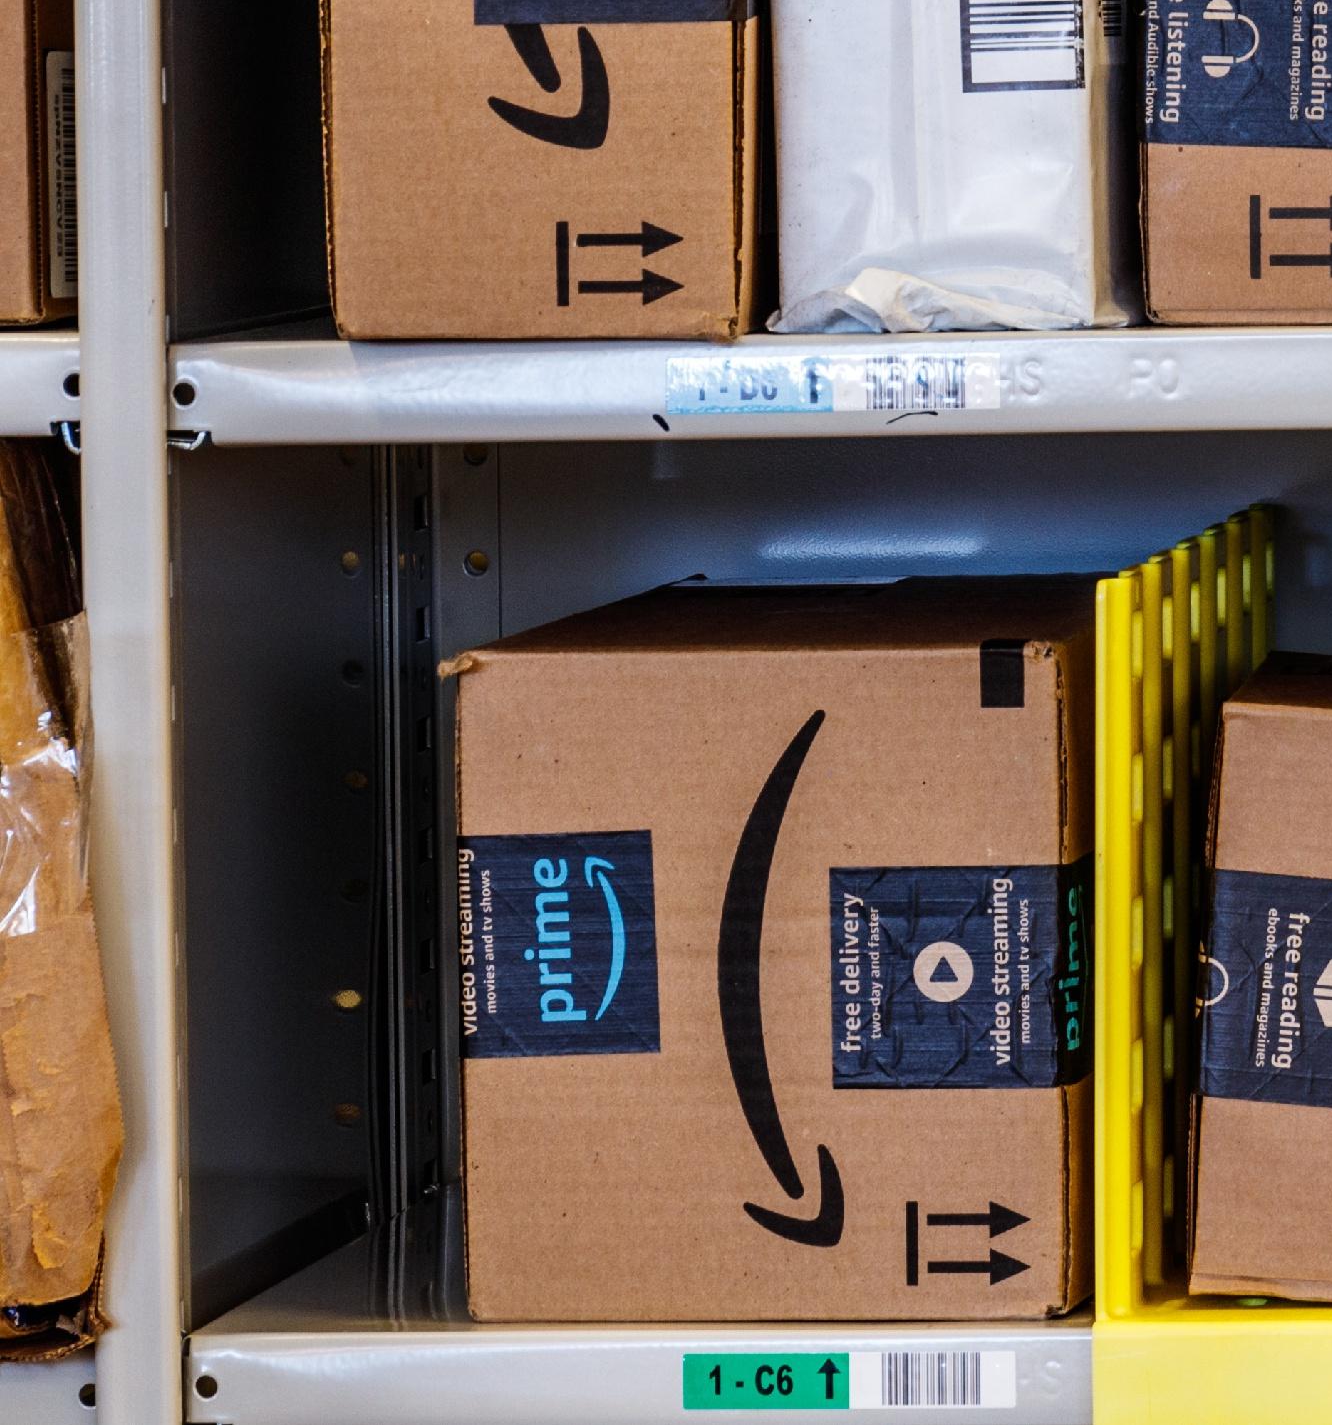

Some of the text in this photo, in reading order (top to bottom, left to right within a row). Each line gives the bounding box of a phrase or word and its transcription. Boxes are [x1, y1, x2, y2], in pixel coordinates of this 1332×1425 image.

[1147, 24, 1159, 76] Audible
[1159, 12, 1188, 123] listening
[1290, 45, 1303, 121] magazines
[1292, 17, 1305, 41] and
[1305, 23, 1332, 121] reading
[1145, 79, 1154, 125] shows
[459, 848, 477, 1036] video streaming
[479, 869, 497, 1014] movies and tv shows
[524, 858, 587, 1022] prime
[839, 893, 864, 1052] free delivery
[868, 907, 883, 1039] two-day and faster
[987, 878, 1013, 1065] video streaming
[1017, 899, 1031, 1044] movies and tv shows
[1059, 887, 1081, 1051] prime
[1255, 907, 1280, 1068] ebooks and magazines
[1272, 912, 1310, 1069] free reading
[708, 1364, 794, 1396] 1 C6
